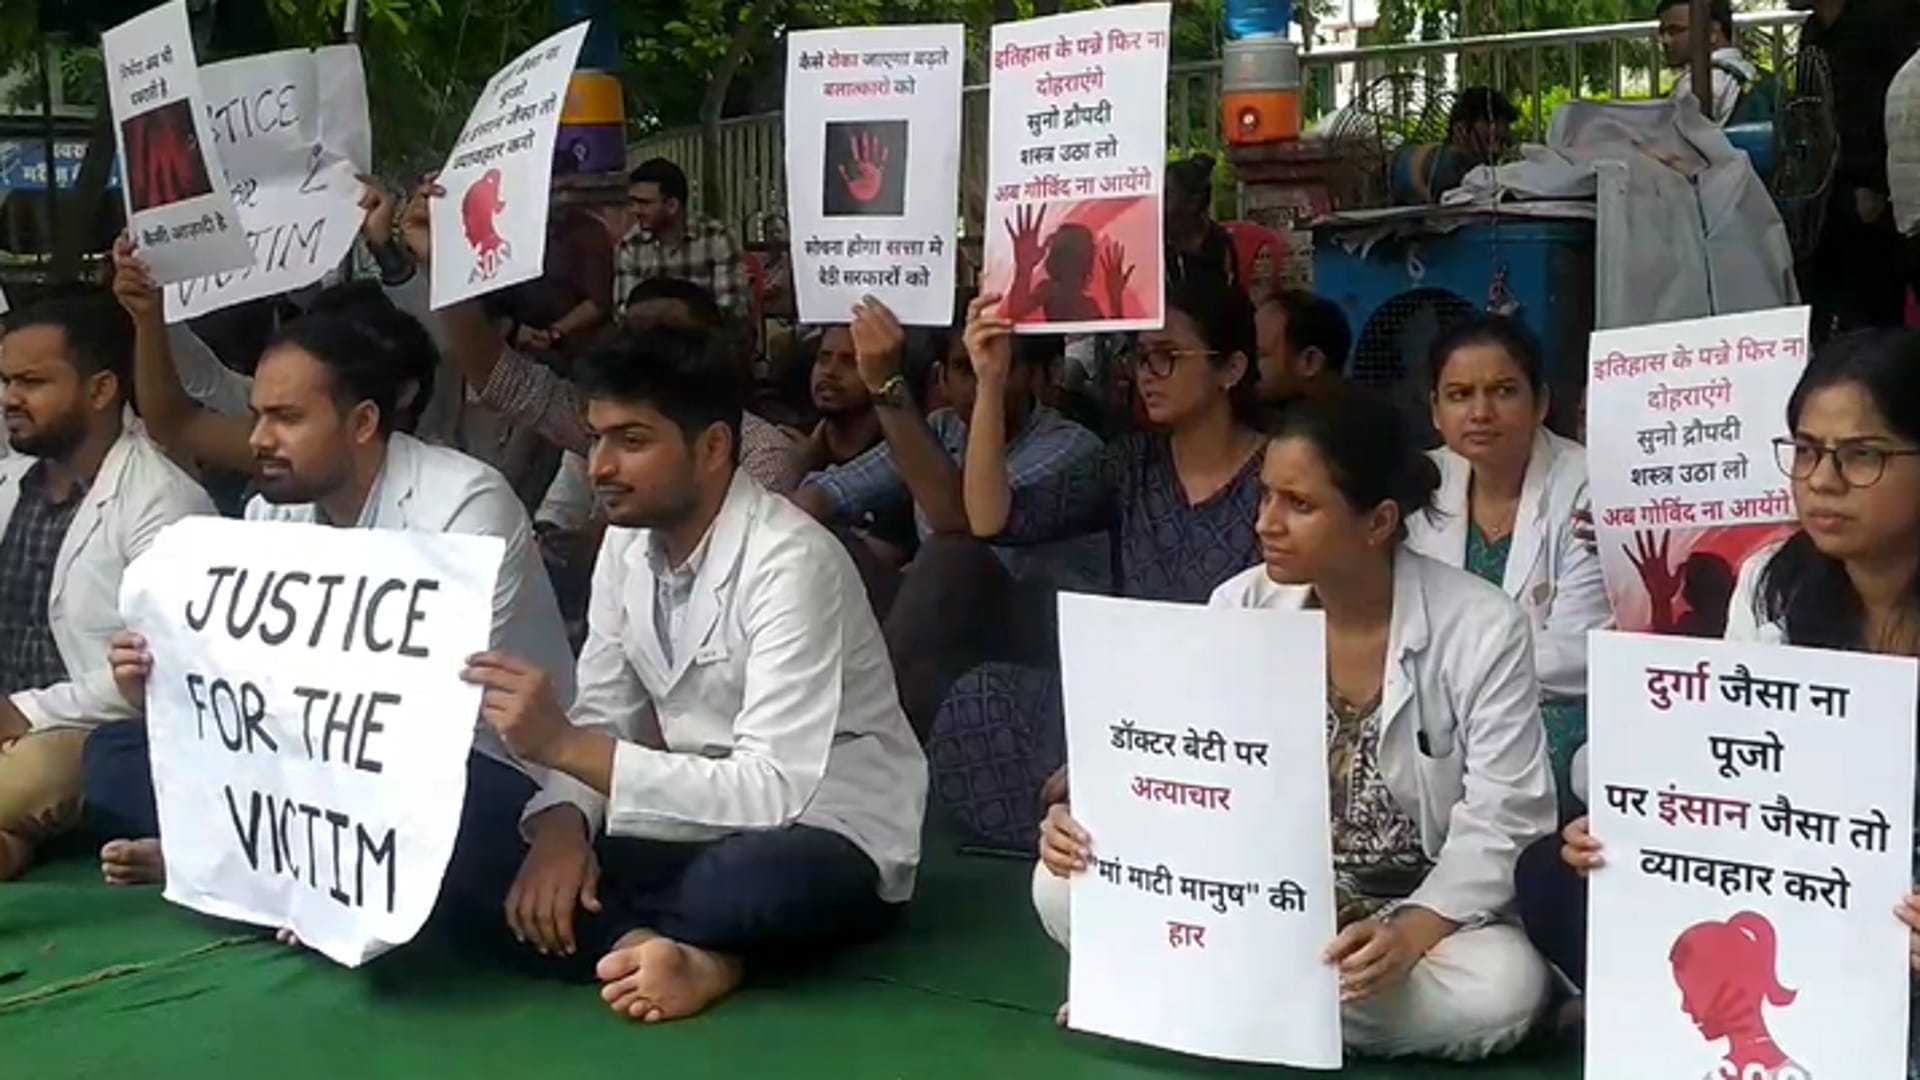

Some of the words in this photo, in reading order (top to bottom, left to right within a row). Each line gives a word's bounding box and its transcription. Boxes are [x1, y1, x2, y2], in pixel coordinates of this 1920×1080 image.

[994, 41, 1050, 70] इतिहास
[1055, 34, 1072, 58] के
[1077, 31, 1103, 55] पन्ने
[1108, 28, 1142, 52] फिर
[1036, 64, 1104, 97] दोहराएंगे
[1027, 104, 1059, 137] सुनो
[1020, 148, 1055, 166] शस्त्र
[1059, 142, 1090, 162] उठा
[1094, 133, 1117, 157] लो
[994, 184, 1020, 202] अब
[1024, 173, 1071, 198] गोविंद
[1075, 175, 1096, 195] ना
[1593, 347, 1665, 380] इतिहास
[1672, 344, 1691, 368] के
[1699, 339, 1729, 366] पन्ने
[1738, 336, 1776, 363] फिर
[1782, 337, 1805, 357] ना
[1647, 377, 1732, 412] दोहराएंगे
[1637, 420, 1676, 455] सुनो
[1631, 465, 1673, 487] शस्त्र
[1680, 461, 1716, 482] उठा
[1723, 453, 1748, 480] लो
[1603, 505, 1636, 527] अब
[1641, 497, 1696, 525] गोविंद
[1701, 499, 1723, 520] ना
[1728, 492, 1792, 517] आयेंगे
[185, 566, 439, 657] JUSTICE
[1646, 662, 1709, 710] दुर्गा
[1719, 664, 1800, 711] जैसा
[1810, 684, 1850, 717] ना
[186, 674, 277, 753] FOR
[293, 685, 401, 773] THE
[1110, 717, 1176, 757] डॉक्टर
[1183, 728, 1226, 764] बेटी
[1236, 740, 1269, 767] पर
[1709, 731, 1784, 777] पूजो
[1131, 774, 1232, 811] अत्याचार
[1606, 784, 1647, 816] पर
[1657, 784, 1750, 830] इंसान
[1761, 796, 1838, 843] जैसा
[1849, 809, 1891, 852] तो
[225, 785, 396, 913] VICTIM
[1128, 865, 1173, 896] माटी
[1180, 875, 1259, 914] मानुष"
[1269, 880, 1307, 912] की
[1640, 847, 1773, 896] व्यावहार
[1784, 867, 1851, 909] करो
[1167, 920, 1206, 948] हार
